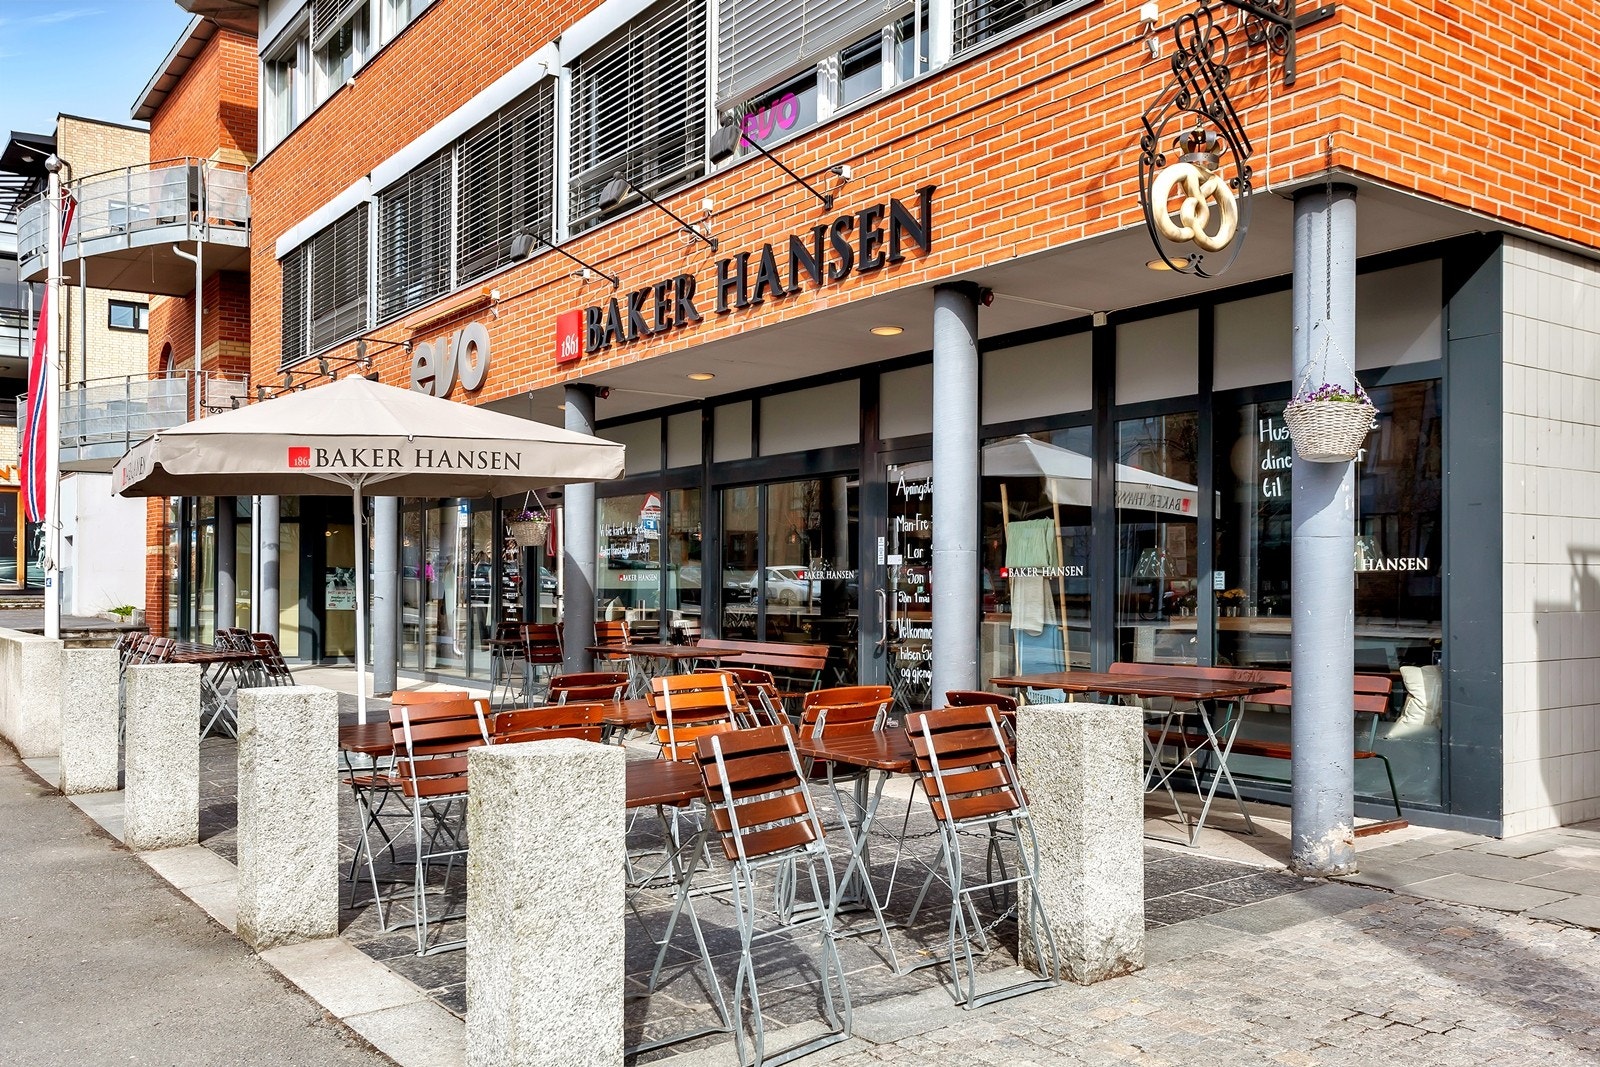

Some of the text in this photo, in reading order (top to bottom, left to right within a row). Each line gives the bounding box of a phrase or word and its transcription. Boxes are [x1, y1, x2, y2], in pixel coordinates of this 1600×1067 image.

[561, 184, 936, 358] 1861 BAKER HANSEN
[410, 321, 490, 398] evo
[1259, 418, 1292, 442] Hus
[294, 447, 522, 471] 1861 BAKER HANSEN
[896, 471, 933, 501] Åpningsti
[1262, 477, 1282, 497] til
[896, 513, 929, 532] Man-Fre
[907, 543, 923, 559] Lør
[1008, 567, 1038, 577] BAKER
[1042, 566, 1084, 577] HANSEN
[1362, 557, 1428, 571] HANSEN
[623, 574, 637, 582] BAKER
[638, 573, 658, 581] HANSEN
[804, 570, 824, 580] BAKER
[826, 570, 855, 580] HANSEN
[907, 568, 924, 584] Søn
[898, 617, 933, 639] Velkomme
[900, 667, 933, 687] og gjeng
